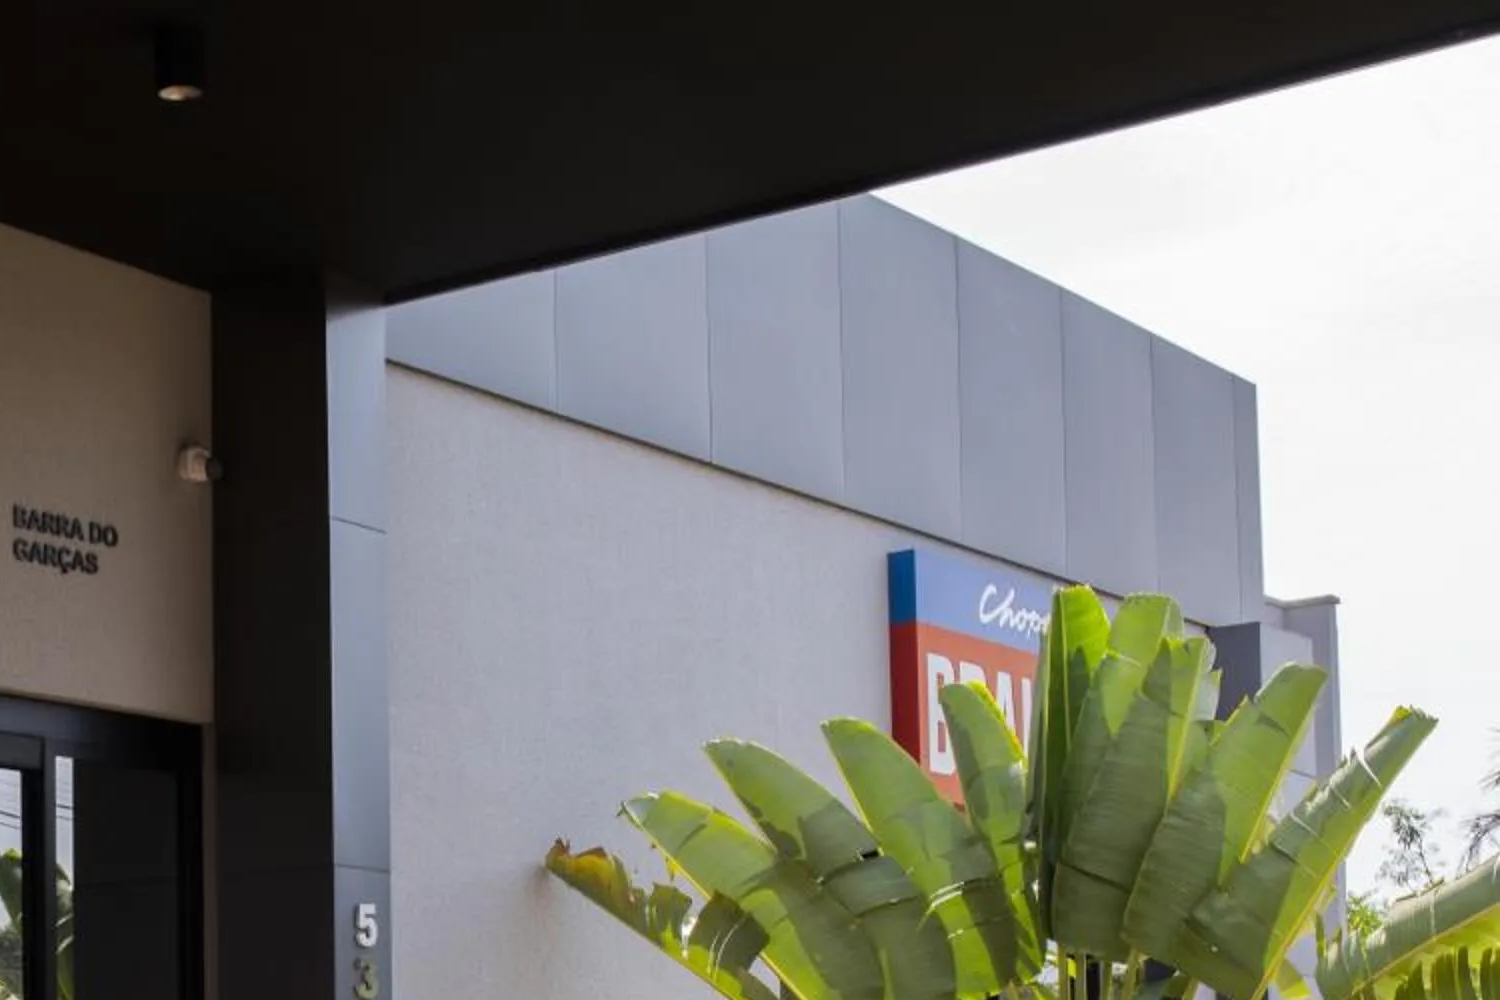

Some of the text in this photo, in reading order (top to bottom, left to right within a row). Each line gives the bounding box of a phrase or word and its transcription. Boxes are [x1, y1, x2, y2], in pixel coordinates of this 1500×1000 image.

[12, 504, 119, 547] BARRA DO
[12, 538, 99, 575] GARÇAS
